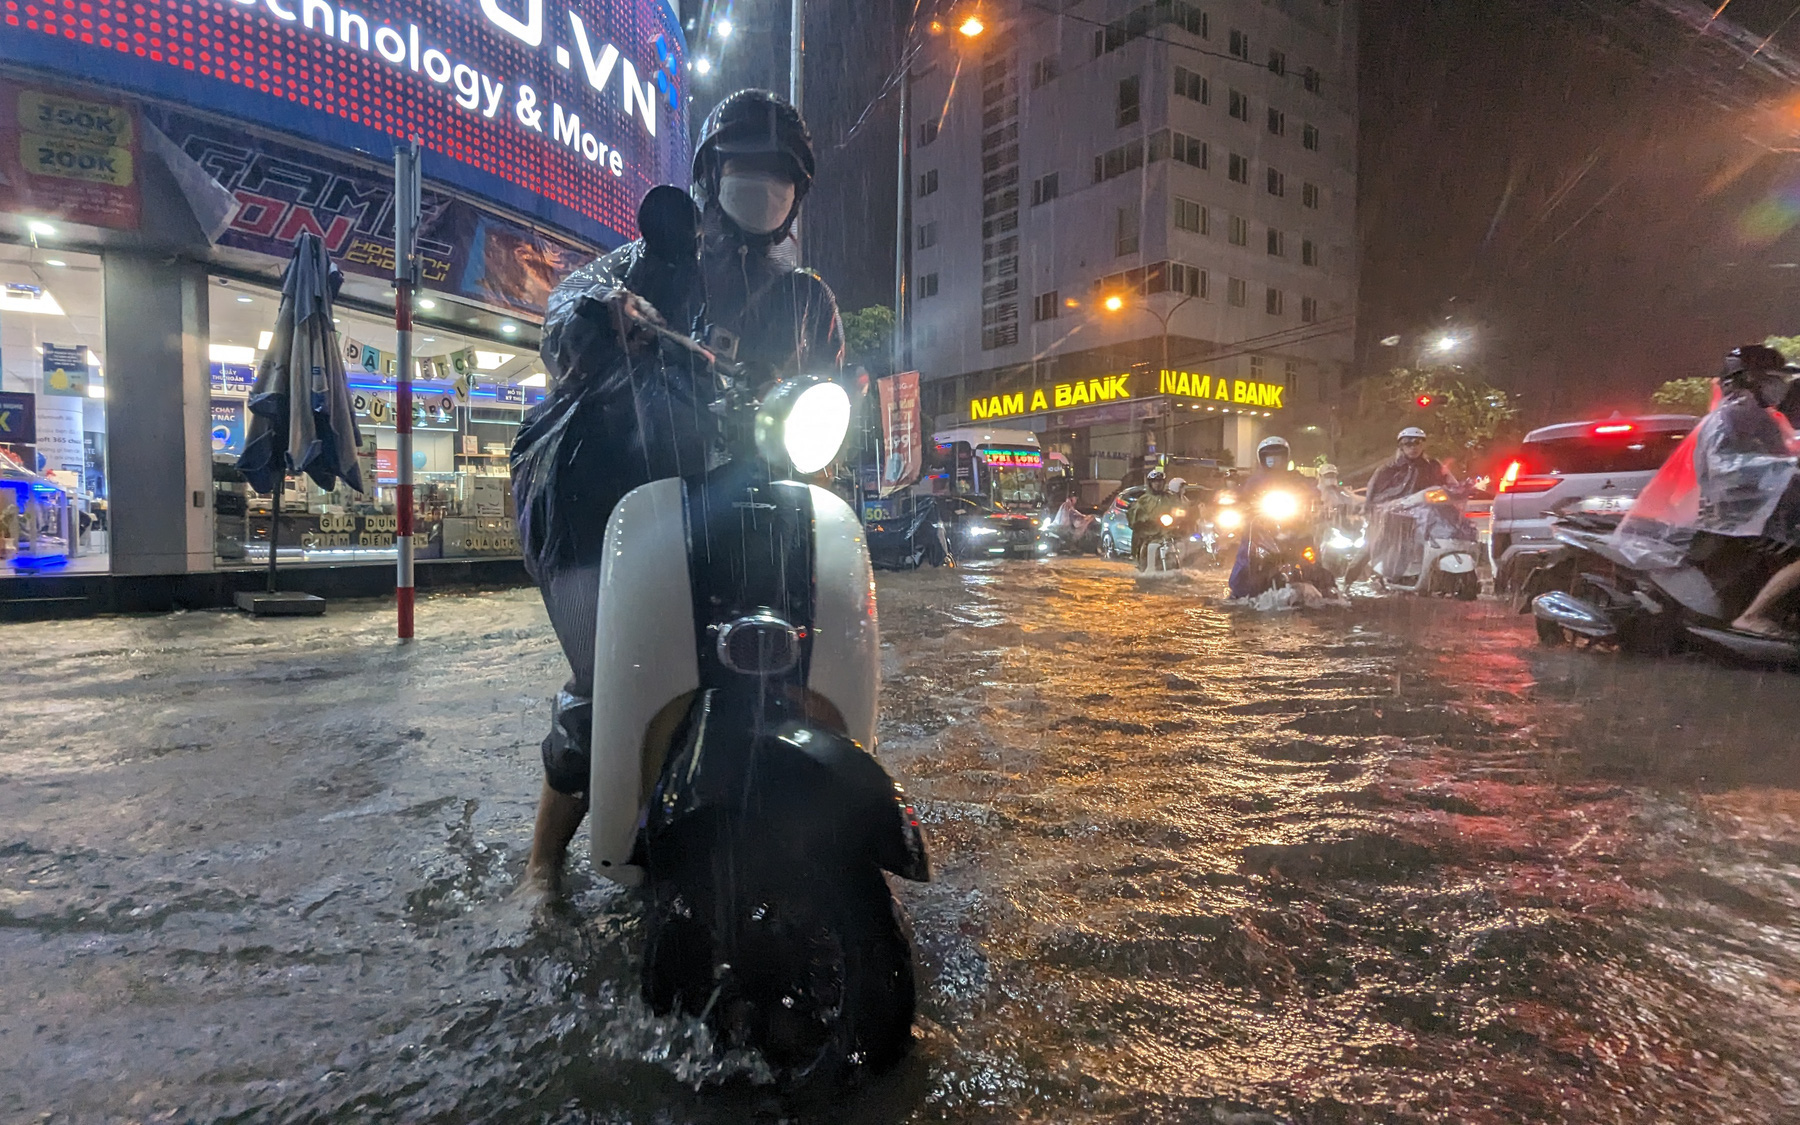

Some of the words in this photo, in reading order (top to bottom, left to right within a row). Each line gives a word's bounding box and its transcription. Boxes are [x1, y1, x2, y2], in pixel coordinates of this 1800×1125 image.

[231, 0, 504, 118] chnology
[515, 84, 543, 133] &
[552, 102, 624, 177] More
[38, 104, 116, 133] 350K
[38, 147, 118, 173] 200K
[181, 134, 454, 256] GAME
[228, 189, 356, 252] ON
[970, 392, 1024, 420] NAM
[1030, 388, 1048, 411] A
[1054, 373, 1130, 407] BANK
[1159, 369, 1211, 398] NAM
[1215, 378, 1229, 401] A
[1233, 380, 1284, 409] BANK
[367, 518, 398, 530] DỤN
